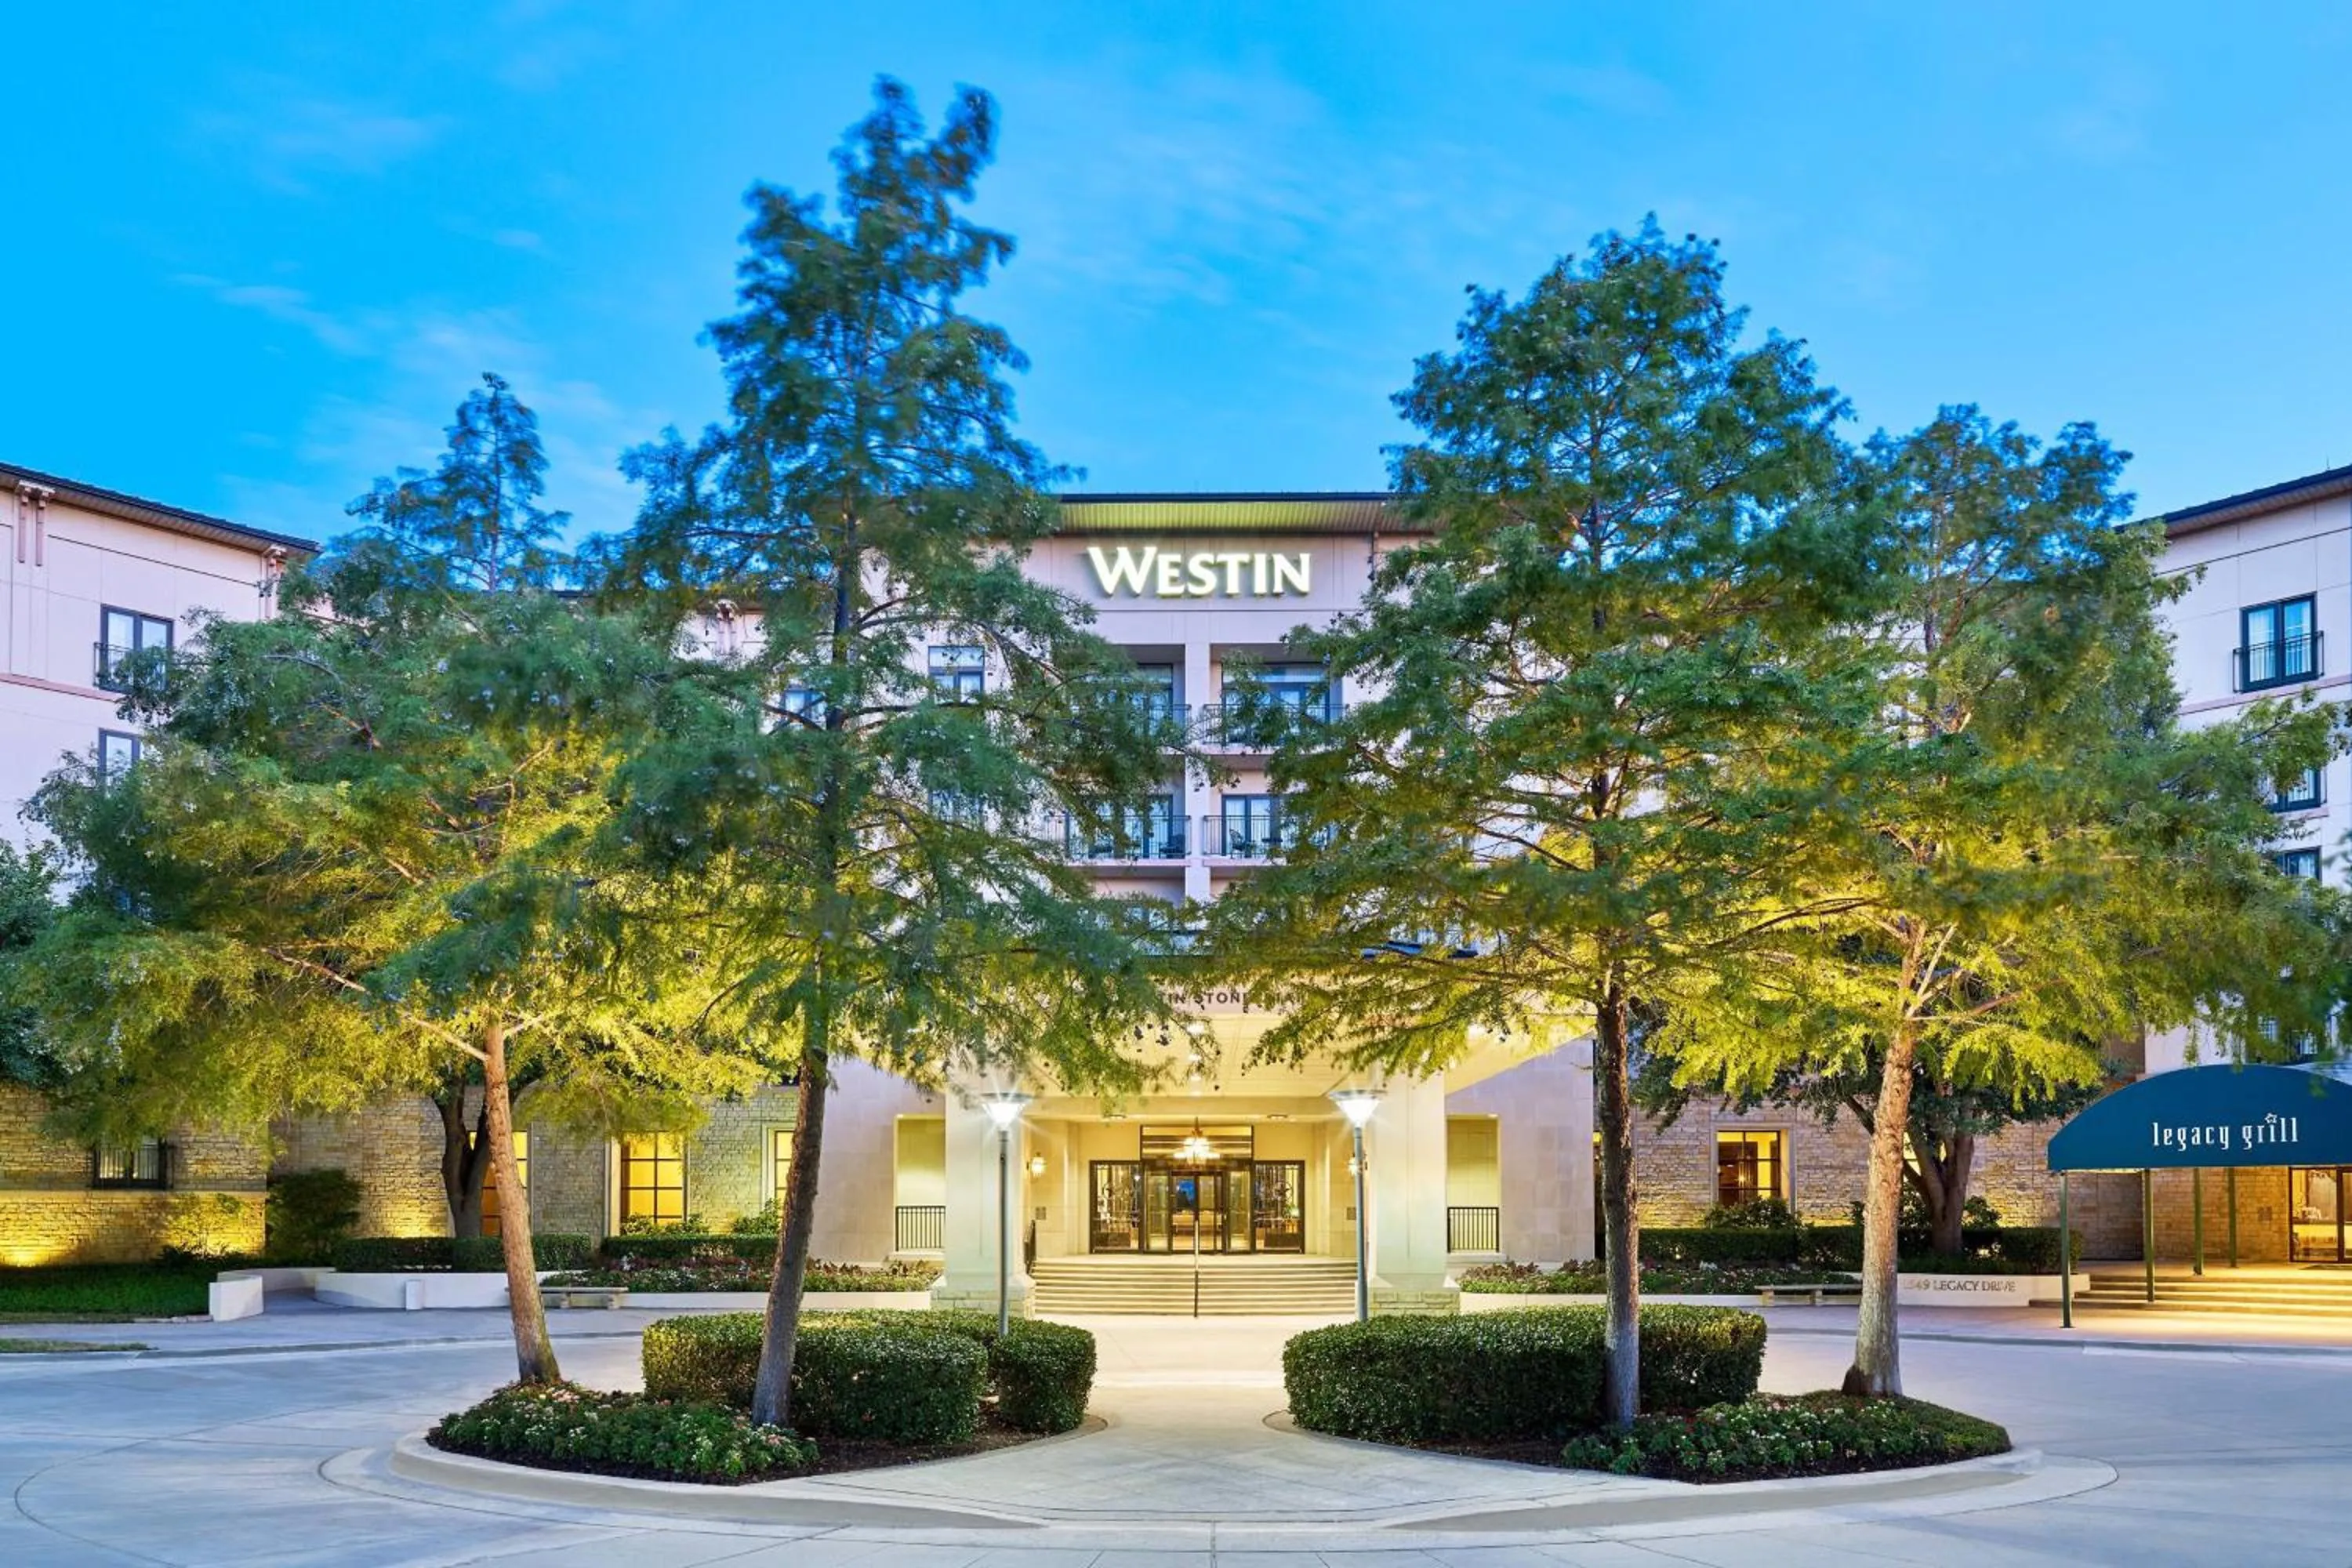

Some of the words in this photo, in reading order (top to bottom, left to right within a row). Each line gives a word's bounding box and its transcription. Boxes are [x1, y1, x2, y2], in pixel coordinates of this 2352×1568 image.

[1087, 546, 1312, 595] WESTIN
[2152, 1123, 2230, 1152] legacy
[2241, 1113, 2299, 1150] grill
[1933, 1279, 1979, 1291] LEGACY
[1982, 1280, 2016, 1292] DRIVE
